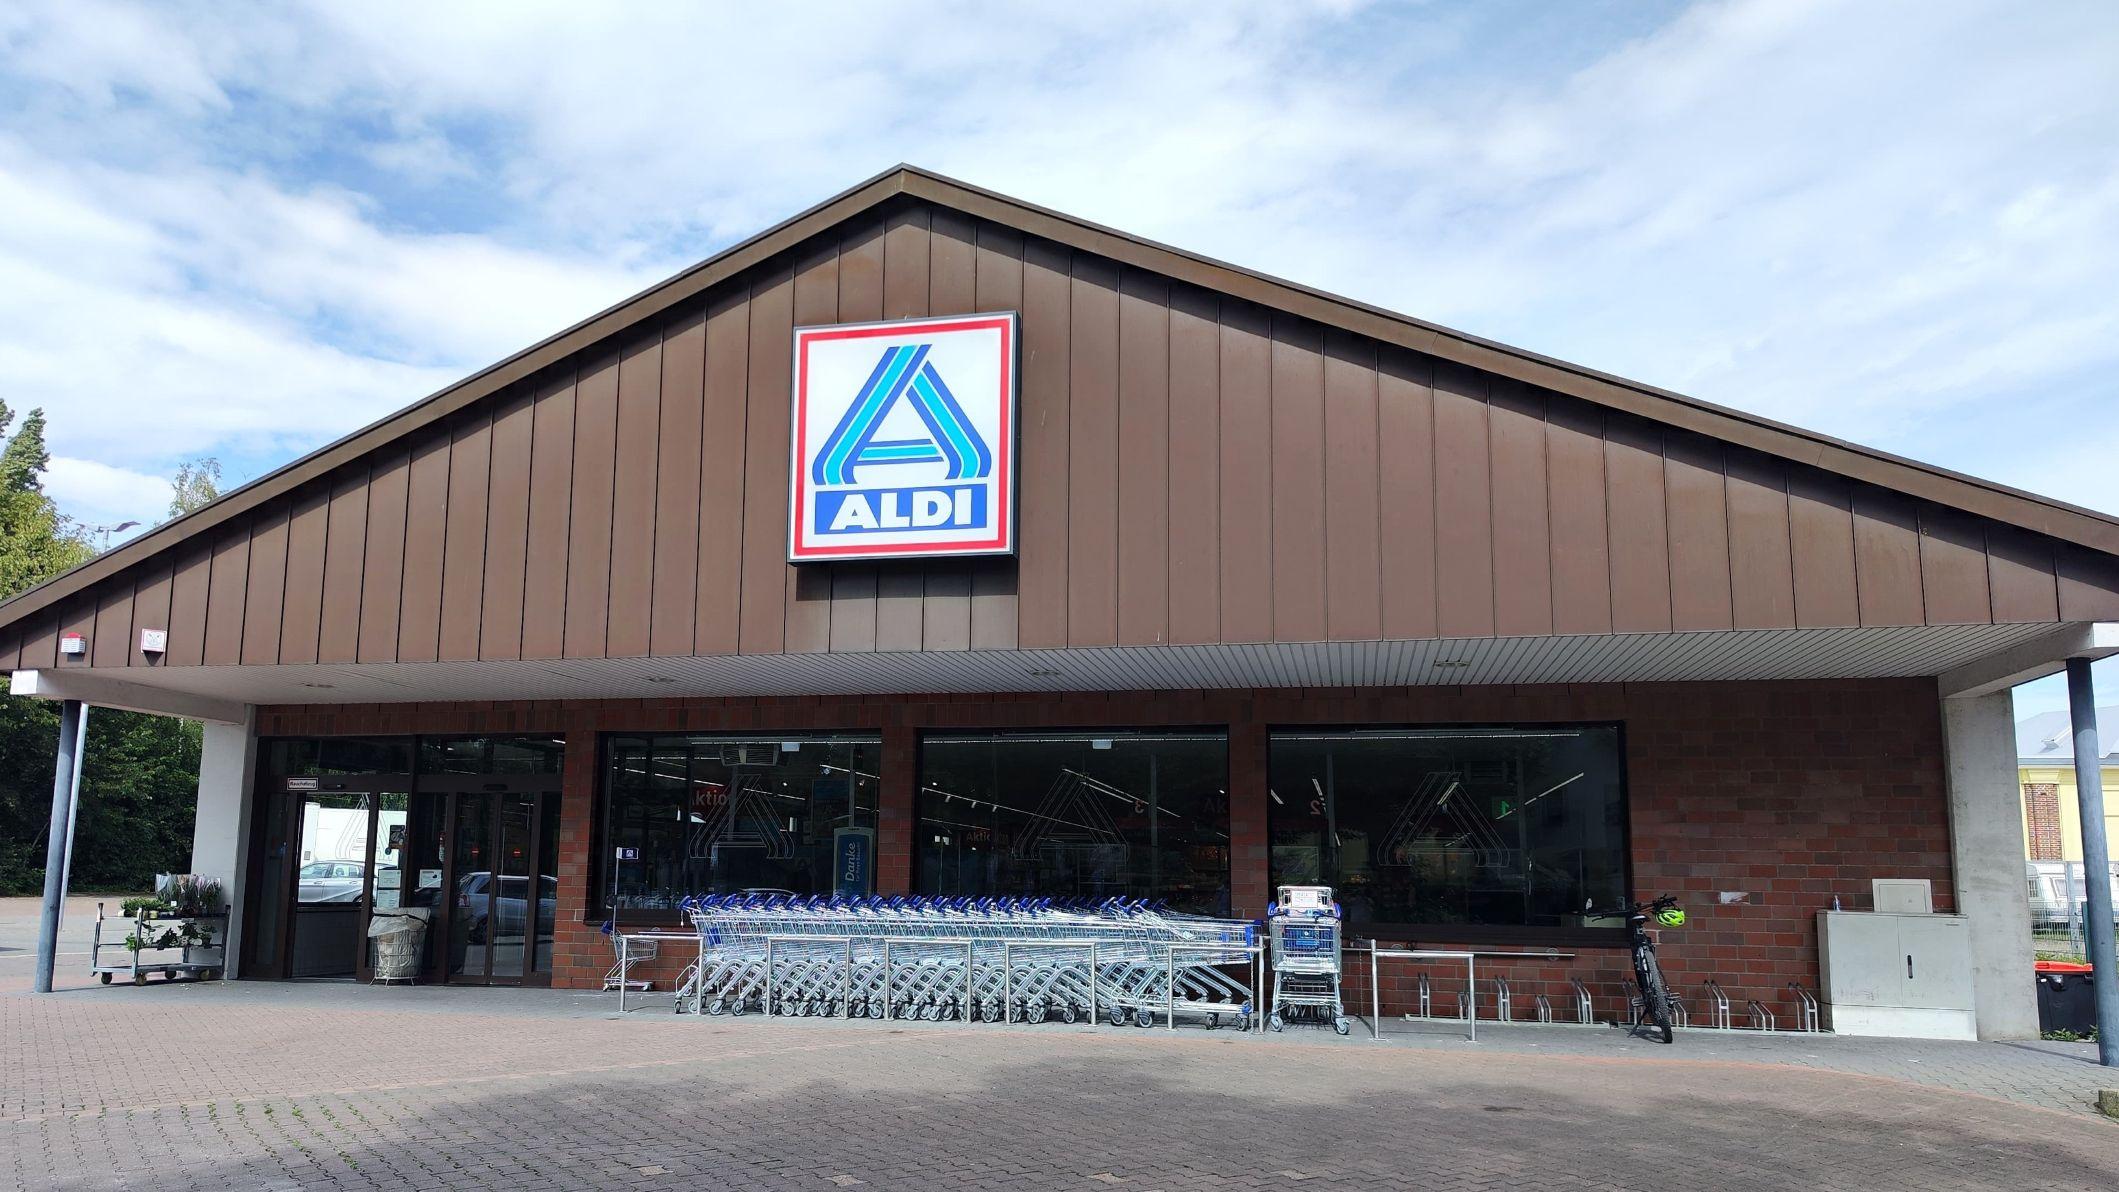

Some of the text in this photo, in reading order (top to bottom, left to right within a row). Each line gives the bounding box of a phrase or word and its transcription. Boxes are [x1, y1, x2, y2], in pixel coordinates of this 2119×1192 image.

[829, 488, 972, 531] ALDI
[692, 789, 728, 806] ktio
[845, 841, 857, 881] Danke
